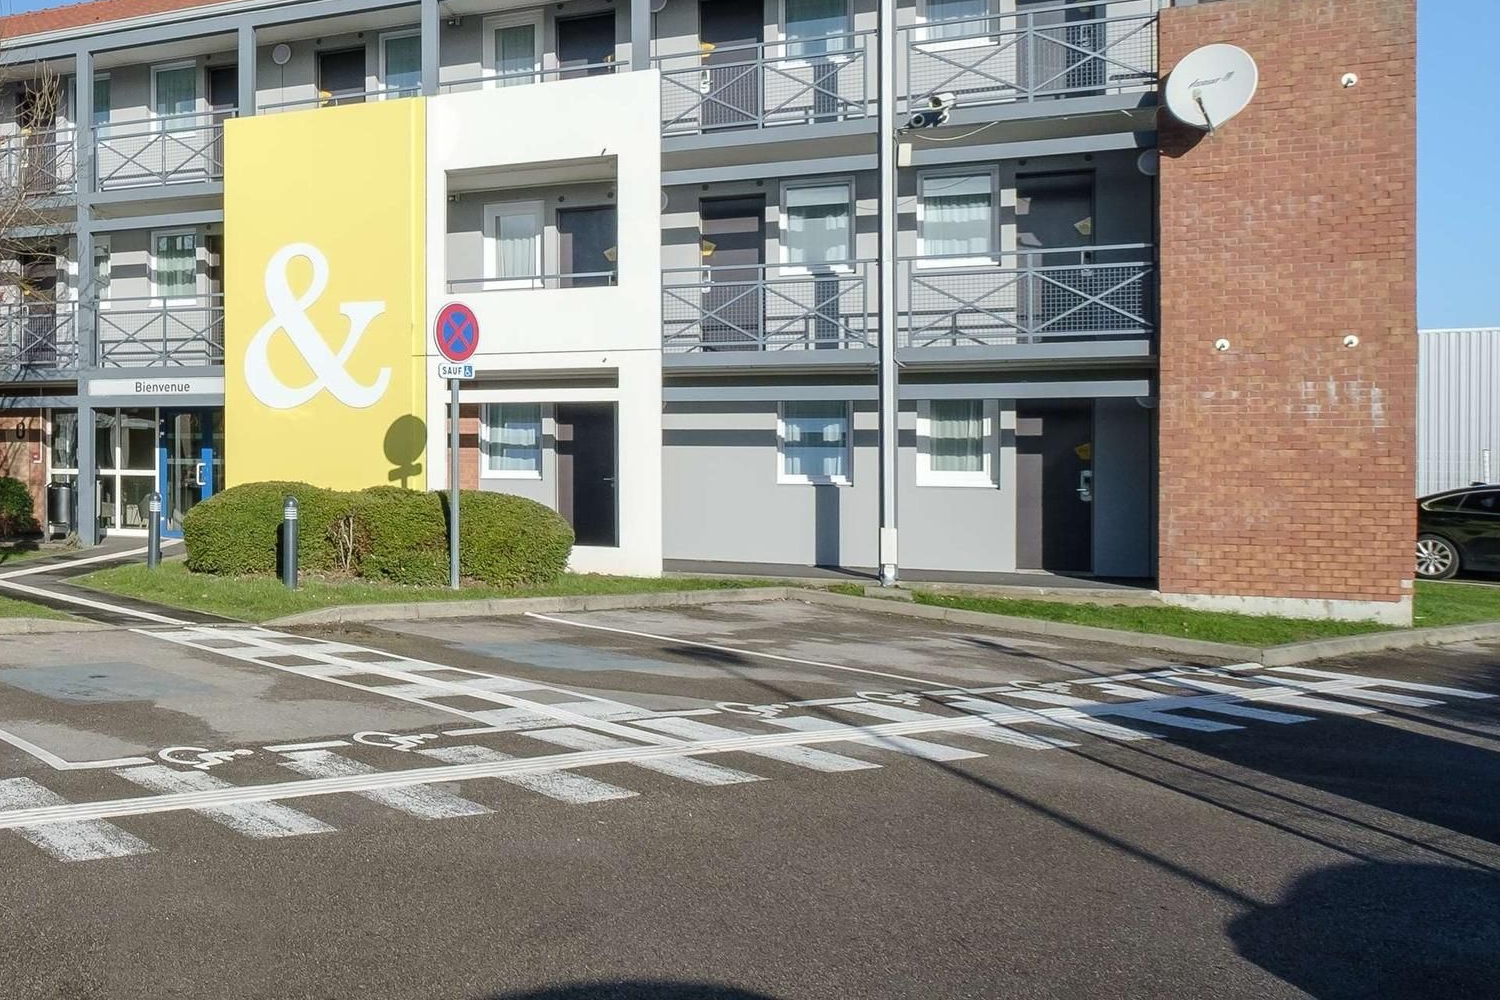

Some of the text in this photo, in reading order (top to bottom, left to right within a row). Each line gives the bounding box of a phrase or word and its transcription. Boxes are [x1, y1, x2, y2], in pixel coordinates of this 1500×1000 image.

[244, 242, 392, 409] &
[442, 366, 462, 375] SAUF
[135, 381, 191, 392] Bienvenue
